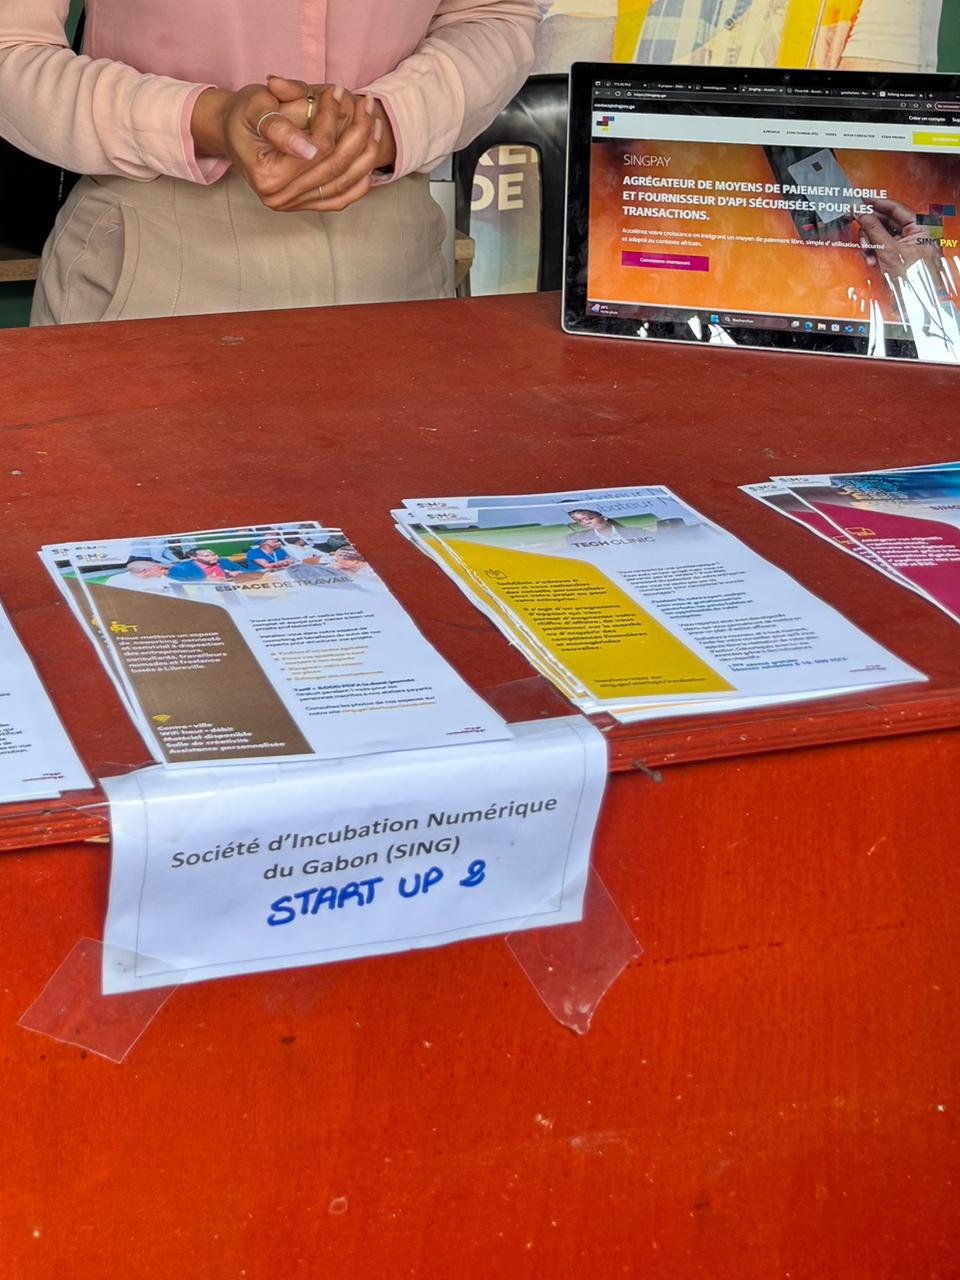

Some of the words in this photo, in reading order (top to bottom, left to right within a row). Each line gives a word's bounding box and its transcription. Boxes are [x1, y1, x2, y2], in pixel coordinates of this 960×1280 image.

[623, 154, 672, 168] SINGPAY
[623, 176, 696, 189] AGRÉGATEUR
[698, 180, 713, 190] DE
[715, 181, 762, 192] MOYENS
[765, 184, 780, 193] DE
[783, 185, 840, 196] PAIEMENT
[843, 188, 887, 199] MOBILE
[623, 191, 637, 200] ET
[638, 192, 715, 205] FOURNISSEUR
[718, 197, 746, 207] D'API
[749, 197, 816, 211] SÉCURISÉES
[819, 202, 851, 213] POUR
[853, 204, 874, 214] LES
[623, 206, 710, 220] TRANSACTIONS.
[214, 581, 271, 593] ESPACE
[171, 838, 259, 869] Société
[426, 797, 558, 827] Numérique
[263, 863, 293, 880] du
[302, 852, 378, 874] Gabon
[386, 836, 461, 864] (SING)
[267, 876, 384, 926] START
[398, 866, 443, 898] UP
